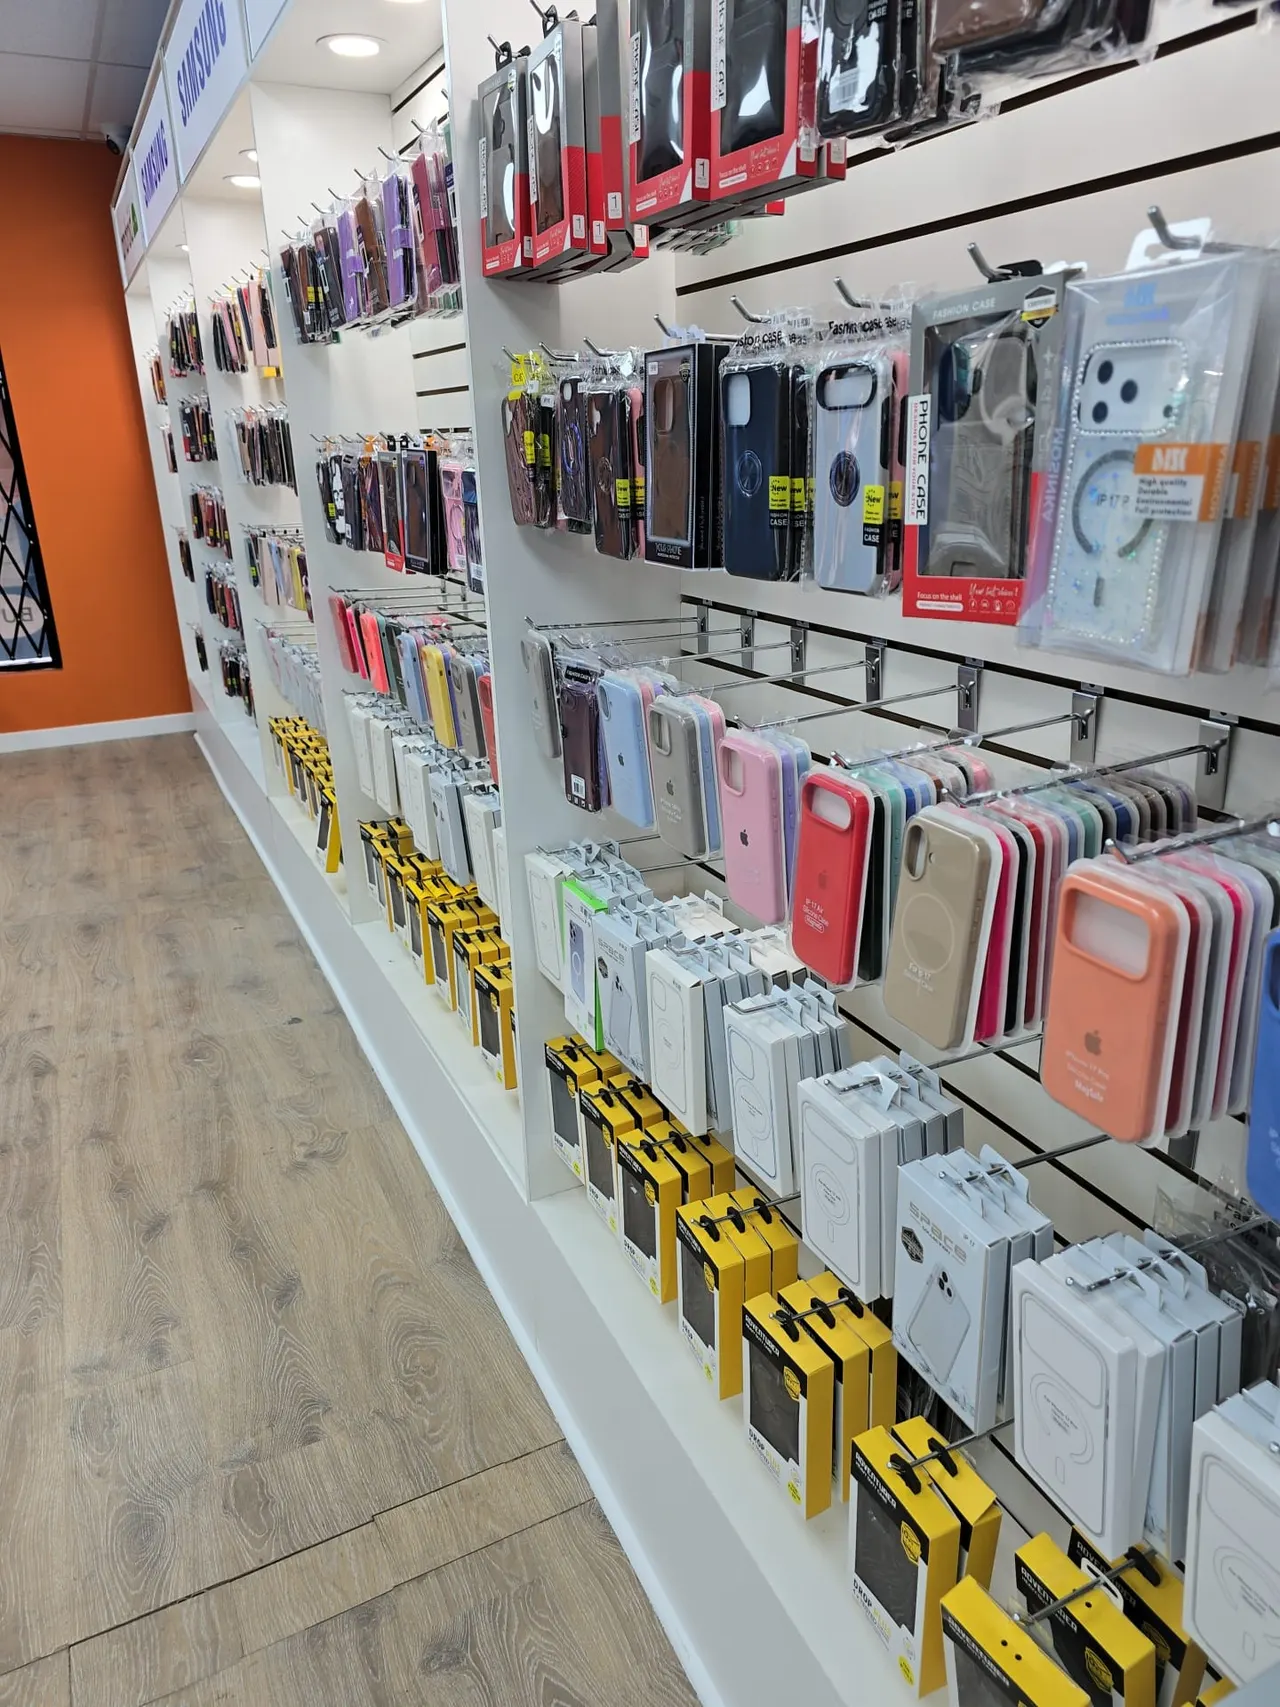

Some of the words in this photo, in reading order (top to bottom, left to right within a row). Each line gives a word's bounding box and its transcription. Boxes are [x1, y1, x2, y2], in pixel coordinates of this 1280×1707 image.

[176, 0, 227, 128] SAMSUNG
[140, 119, 168, 209] SAMSUNG
[932, 303, 970, 320] FASHION
[972, 297, 996, 312] CASE
[918, 399, 929, 464] PHONE
[771, 484, 788, 492] New
[1139, 477, 1157, 487] High
[1160, 478, 1188, 488] quality
[915, 474, 927, 520] CASE
[1138, 487, 1169, 496] Durable
[866, 495, 881, 504] New
[1136, 497, 1193, 506] Environmental
[1135, 506, 1149, 514] Full
[1151, 507, 1193, 516] protection
[770, 518, 788, 526] CASE
[863, 534, 880, 543] CASE
[917, 591, 932, 599] Focus
[940, 592, 949, 600] the
[949, 592, 963, 601] shell
[855, 1451, 897, 1509] ADVENTURER
[853, 1578, 873, 1607] DROP
[1020, 1566, 1078, 1634] ADVENTRER
